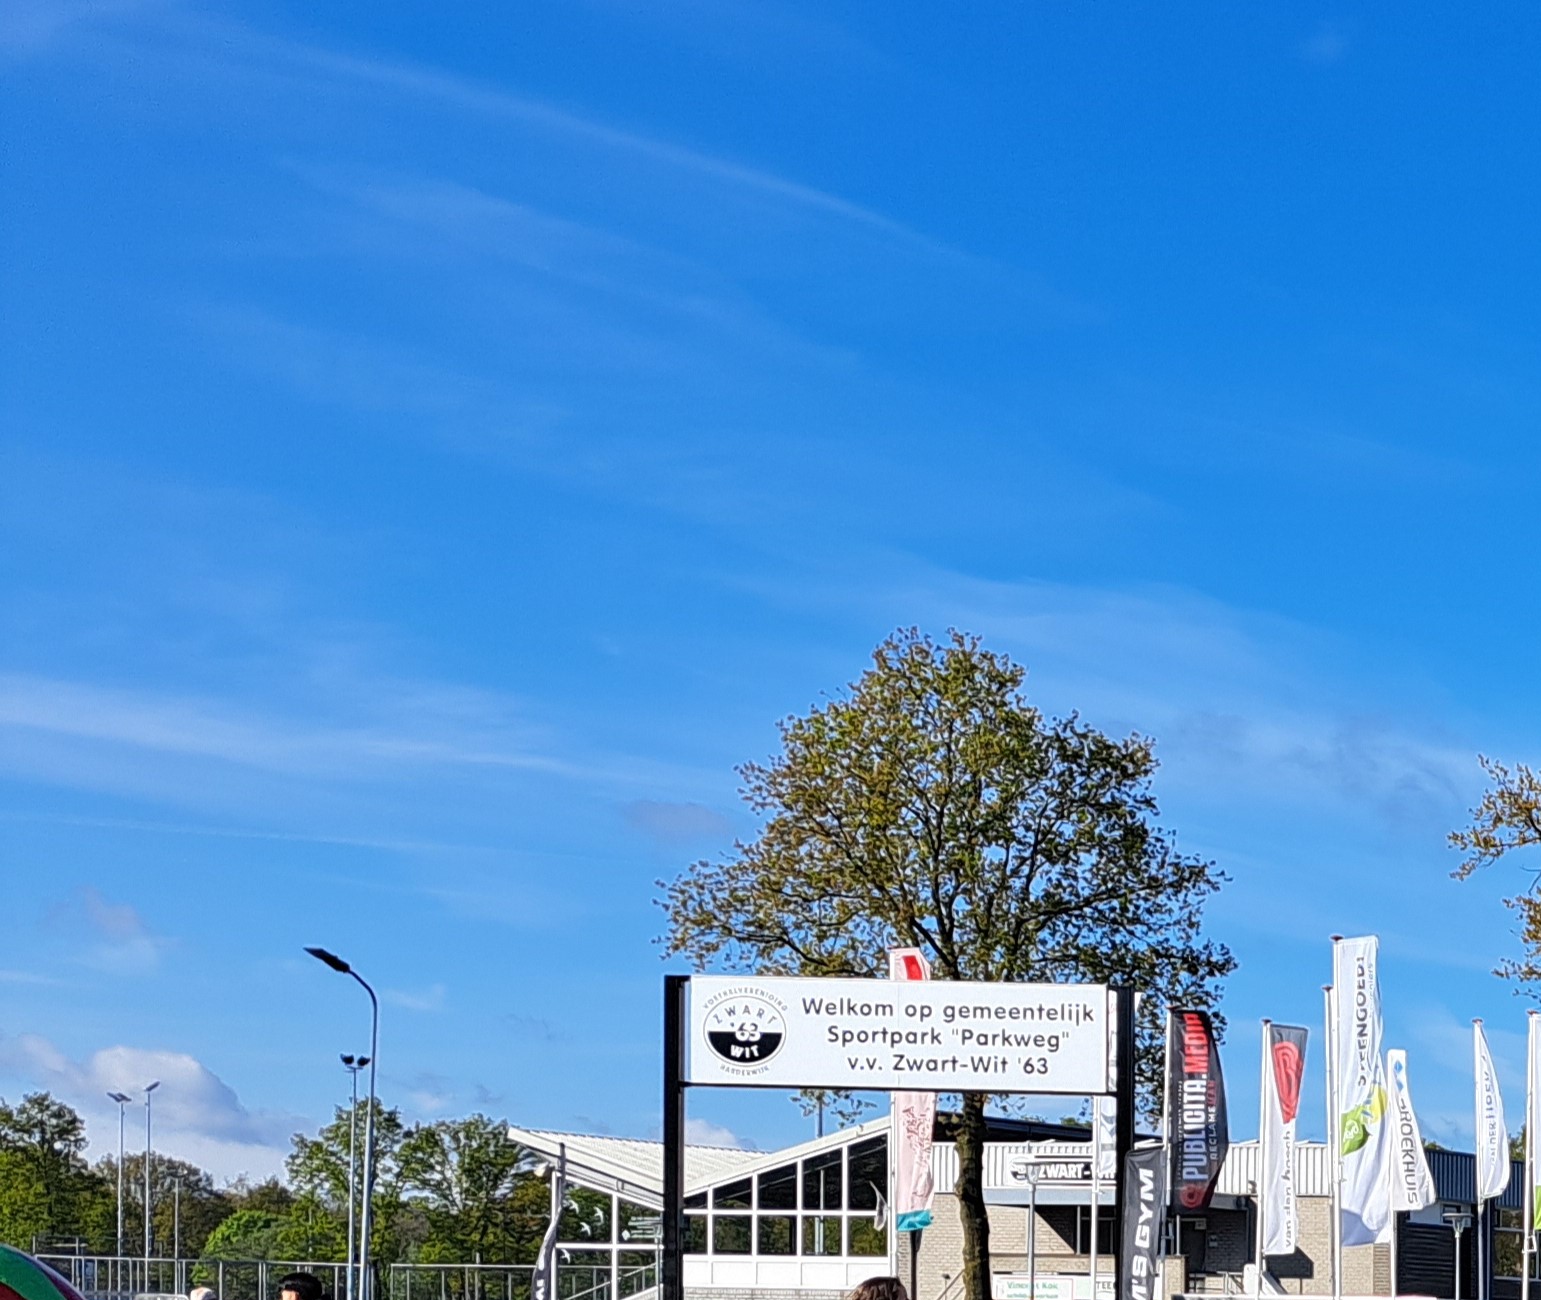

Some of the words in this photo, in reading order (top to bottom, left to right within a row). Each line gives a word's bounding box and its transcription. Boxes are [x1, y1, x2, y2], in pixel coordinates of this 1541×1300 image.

[713, 1005, 778, 1024] ZWART
[802, 997, 894, 1016] Welkom
[905, 1004, 933, 1022] op
[943, 1003, 1094, 1026] gemeentelijk
[827, 1025, 942, 1048] Sportpark
[952, 1028, 1070, 1052] "Parkweg"
[730, 1044, 759, 1059] WIT
[847, 1057, 883, 1070] v.v.
[892, 1054, 1009, 1073] Zwart-Wit
[1018, 1057, 1049, 1075] '63
[1039, 1163, 1115, 1179] ZWART-
[1135, 1168, 1154, 1249] GYM
[1007, 1281, 1040, 1290] Vinct
